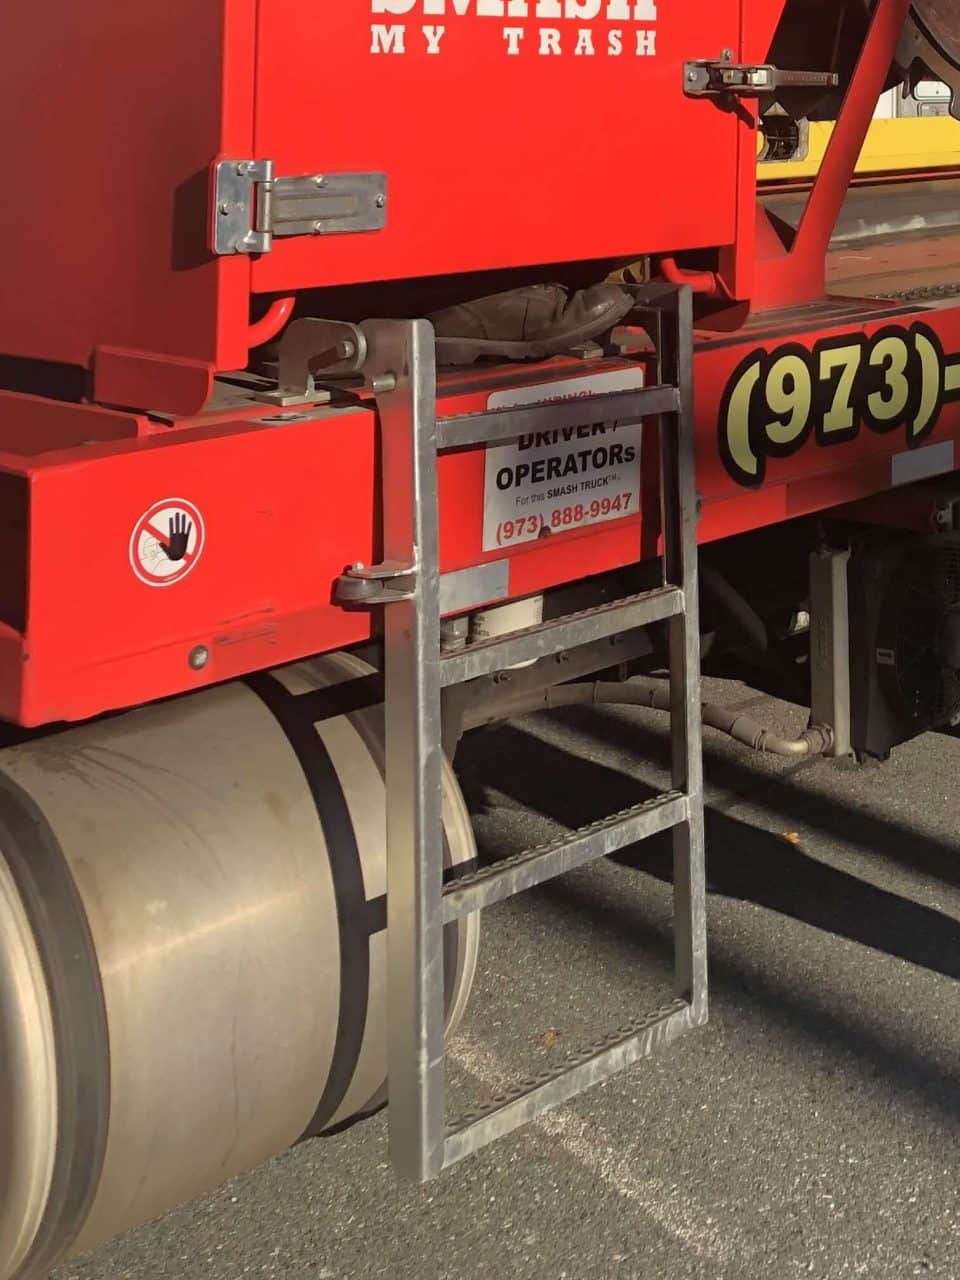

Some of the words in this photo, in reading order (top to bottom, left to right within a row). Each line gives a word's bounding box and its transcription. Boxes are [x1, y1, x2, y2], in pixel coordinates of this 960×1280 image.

[370, 24, 445, 54] MY
[503, 27, 657, 56] TRASH
[515, 495, 529, 507] For
[531, 490, 546, 503] this
[547, 482, 578, 499] SMASH
[496, 513, 543, 545] (973)
[551, 492, 633, 528] 888-9947
